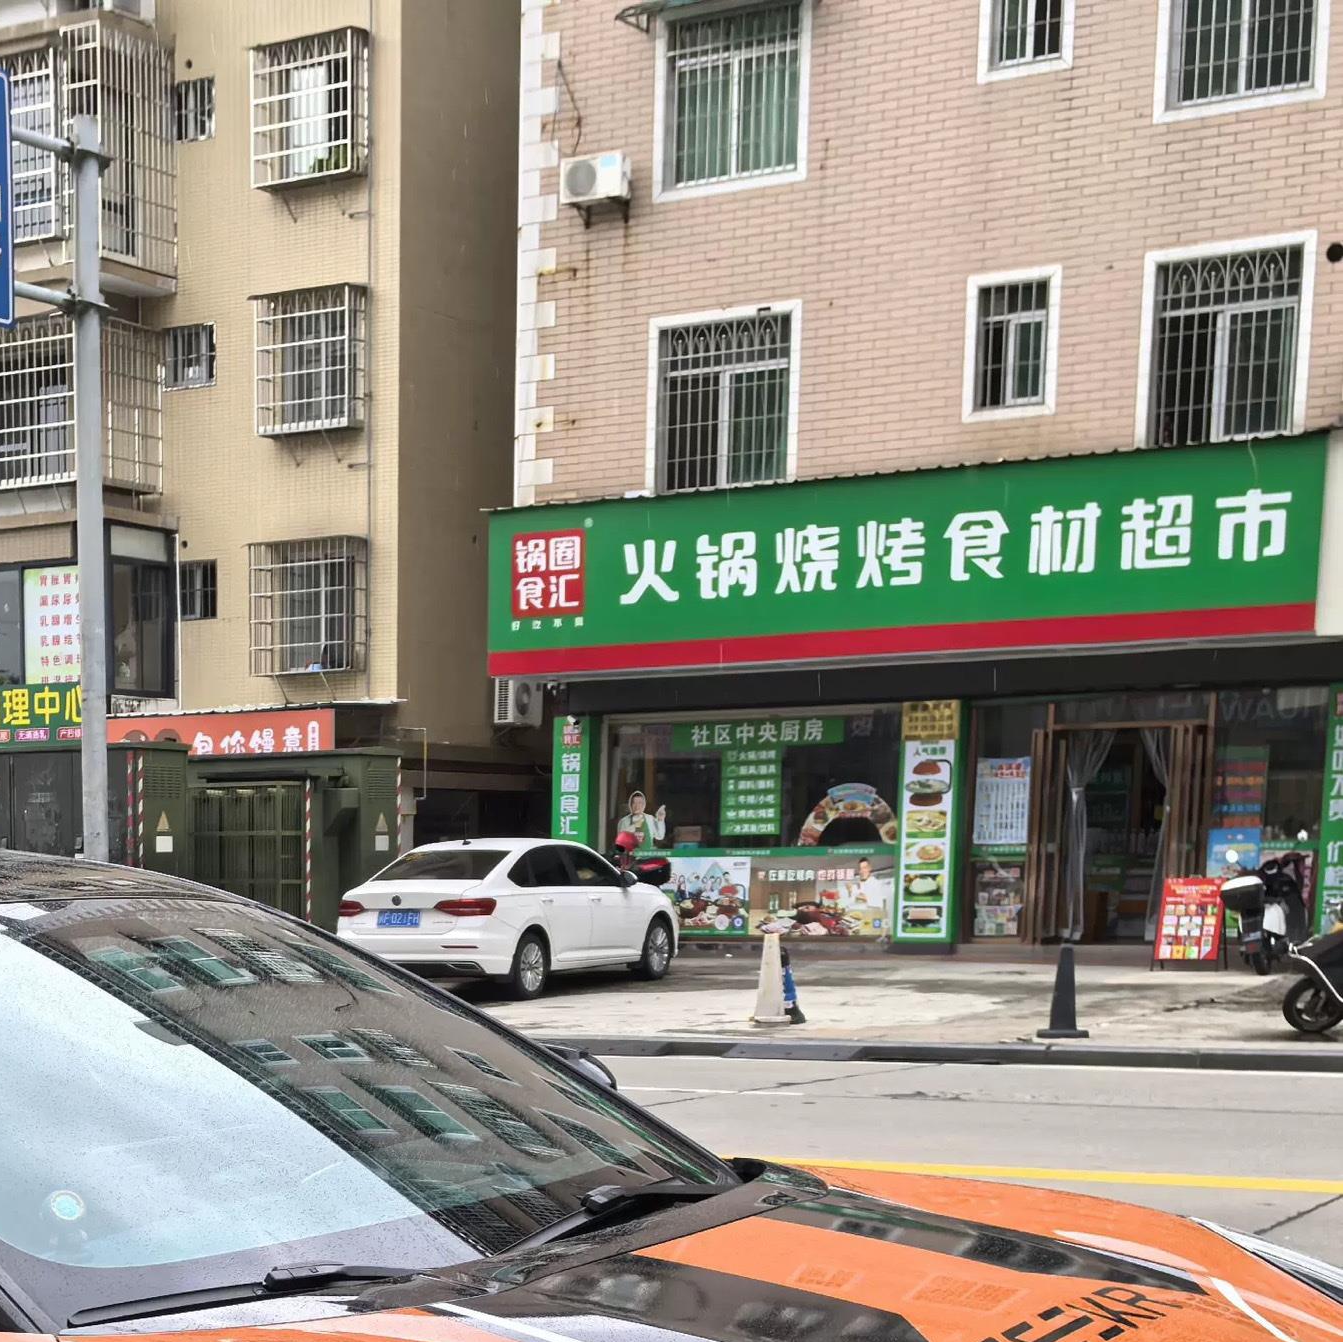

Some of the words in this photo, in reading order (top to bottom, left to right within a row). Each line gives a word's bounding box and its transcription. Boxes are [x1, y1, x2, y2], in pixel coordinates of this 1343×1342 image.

[515, 536, 581, 573] 锅圈
[619, 488, 1294, 605] 火锅烧烤食材超市
[515, 574, 580, 610] 食汇
[691, 719, 825, 748] 社区中央厨房
[560, 752, 581, 836] 锅圈食汇
